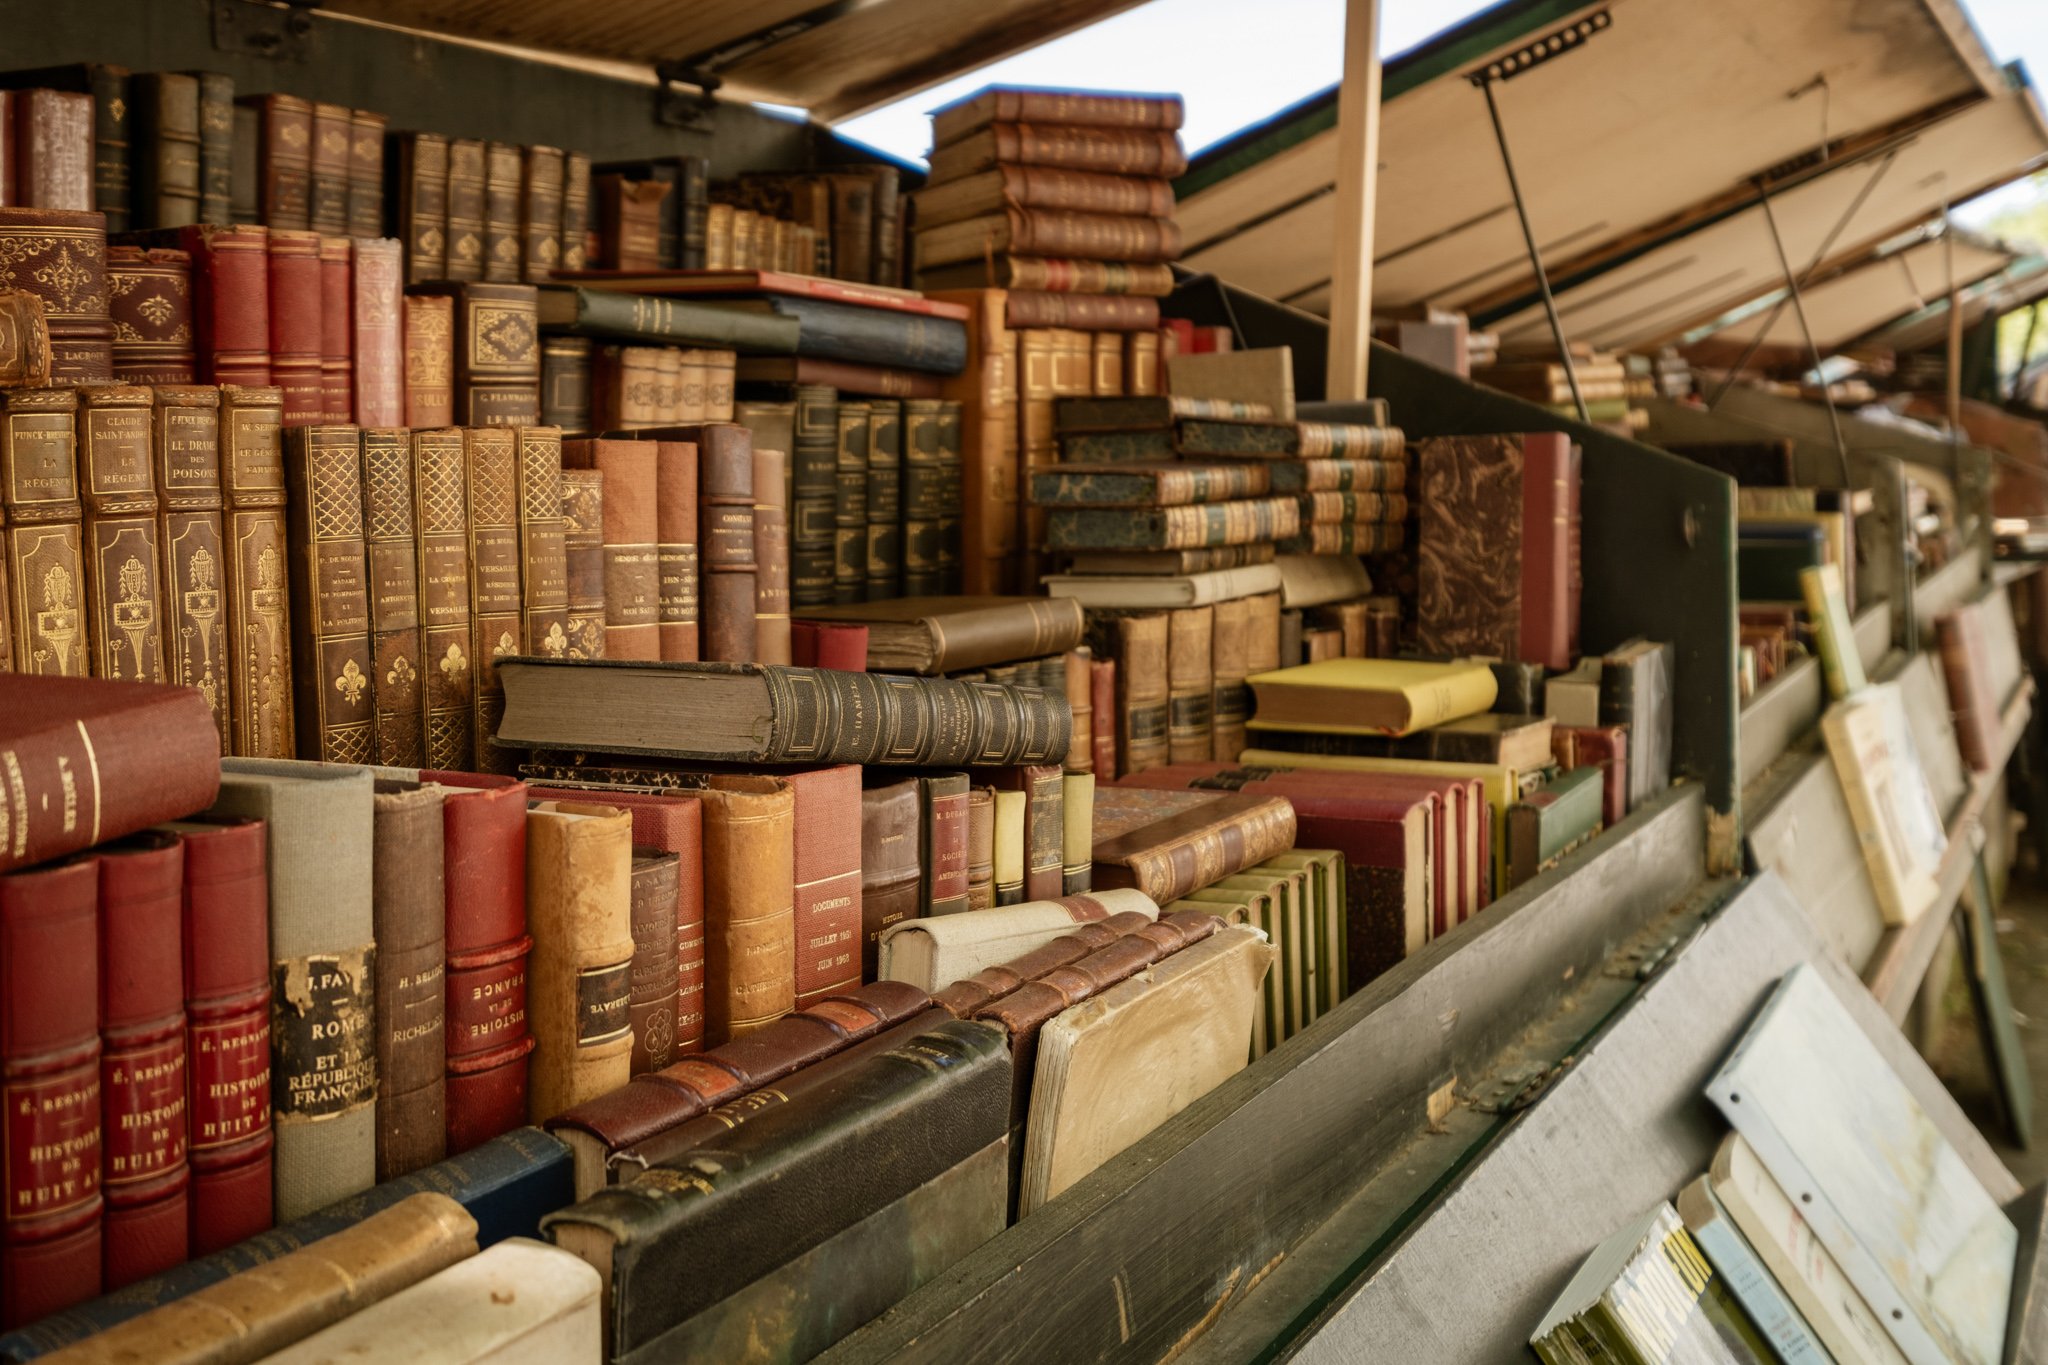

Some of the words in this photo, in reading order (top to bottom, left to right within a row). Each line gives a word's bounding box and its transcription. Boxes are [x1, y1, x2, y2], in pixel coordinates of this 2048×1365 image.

[107, 418, 142, 426] CLAUDE
[172, 440, 184, 451] LE
[190, 440, 216, 451] DRAME
[240, 449, 251, 457] LE
[43, 458, 56, 468] LA
[121, 459, 136, 467] LE
[173, 469, 216, 479] POISONS
[623, 607, 637, 615] ROI
[850, 681, 863, 729] HAMEL
[949, 715, 956, 727] DE
[813, 896, 851, 913] DOCUMENTS
[817, 957, 833, 971] JUIN
[321, 965, 368, 989] FAVE
[399, 977, 414, 990] H.
[473, 972, 525, 1001] FRANCE
[488, 1002, 500, 1014] LA
[311, 1013, 365, 1040] ROME
[470, 1009, 525, 1037] HISTOIRE
[315, 1054, 338, 1071] ET
[344, 1049, 362, 1064] LA
[241, 1097, 257, 1111] DE
[204, 1118, 253, 1137] HUIT
[259, 1104, 271, 1123] AN
[152, 1127, 169, 1142] DE
[113, 1147, 166, 1172] HUIT
[173, 1137, 187, 1156] AN
[62, 1157, 80, 1173] DE
[19, 1180, 75, 1206] HUIT
[84, 1167, 99, 1189] AN
